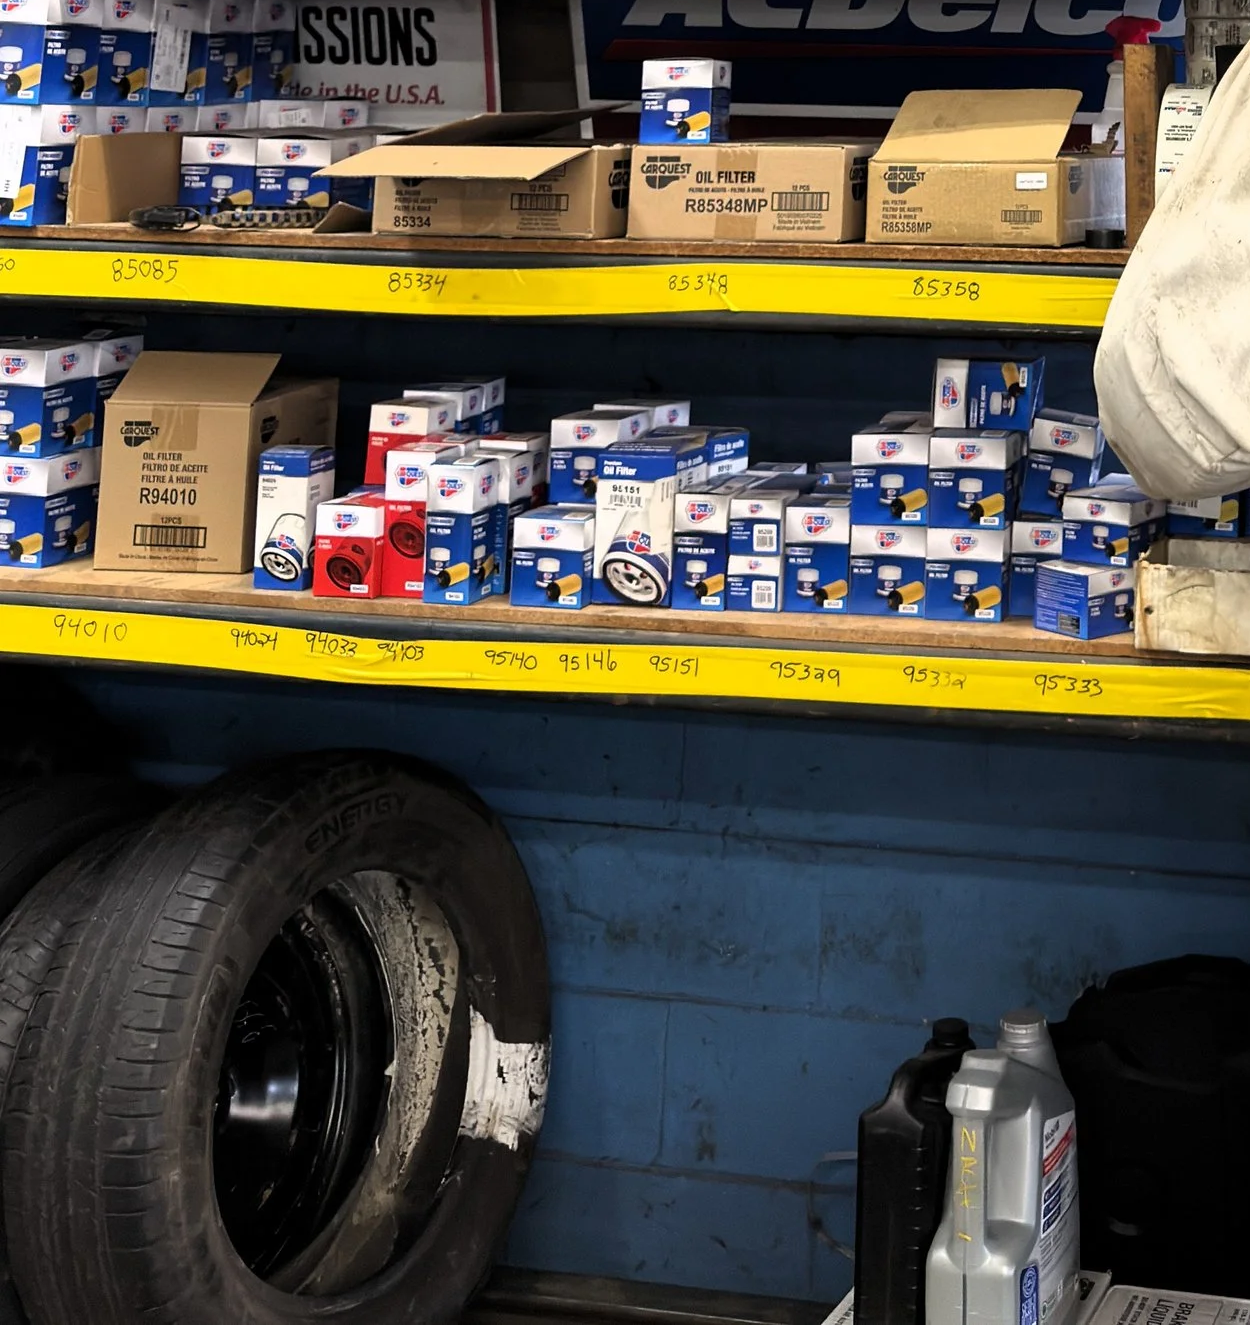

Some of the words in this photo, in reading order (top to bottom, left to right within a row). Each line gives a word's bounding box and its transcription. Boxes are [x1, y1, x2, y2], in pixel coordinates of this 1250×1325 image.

[297, 6, 438, 68] SSIONS
[319, 82, 338, 97] in
[344, 82, 379, 104] the
[384, 82, 445, 106] U.S.A.
[640, 163, 691, 176] CARQUEST
[696, 171, 713, 184] OIL
[716, 171, 756, 183] FILTER
[882, 170, 926, 182] CARQUEST
[685, 198, 768, 214] R85348MP
[393, 216, 431, 227] 85334
[881, 222, 932, 233] R85358MP
[112, 258, 179, 283] 85085
[388, 272, 447, 295] 85334
[913, 277, 980, 301] 85358
[119, 426, 160, 436] CARQUEST
[143, 452, 157, 460] OIL
[158, 453, 182, 461] FILTER
[142, 463, 167, 472] FILTRO
[169, 464, 180, 472] DE
[182, 464, 208, 473] ACEITE
[603, 466, 615, 475] Oil
[616, 467, 637, 476] Filter
[141, 475, 165, 483] FILTRE
[176, 476, 198, 484] HUILE
[612, 485, 641, 494] 95151
[139, 488, 197, 505] R94010
[160, 516, 182, 525] 12PCS
[54, 613, 127, 642] 94010
[485, 649, 538, 671] 95140
[559, 649, 618, 673] 95146
[649, 652, 699, 677] 95151
[769, 661, 841, 687] 95329
[1034, 673, 1104, 698] 95333
